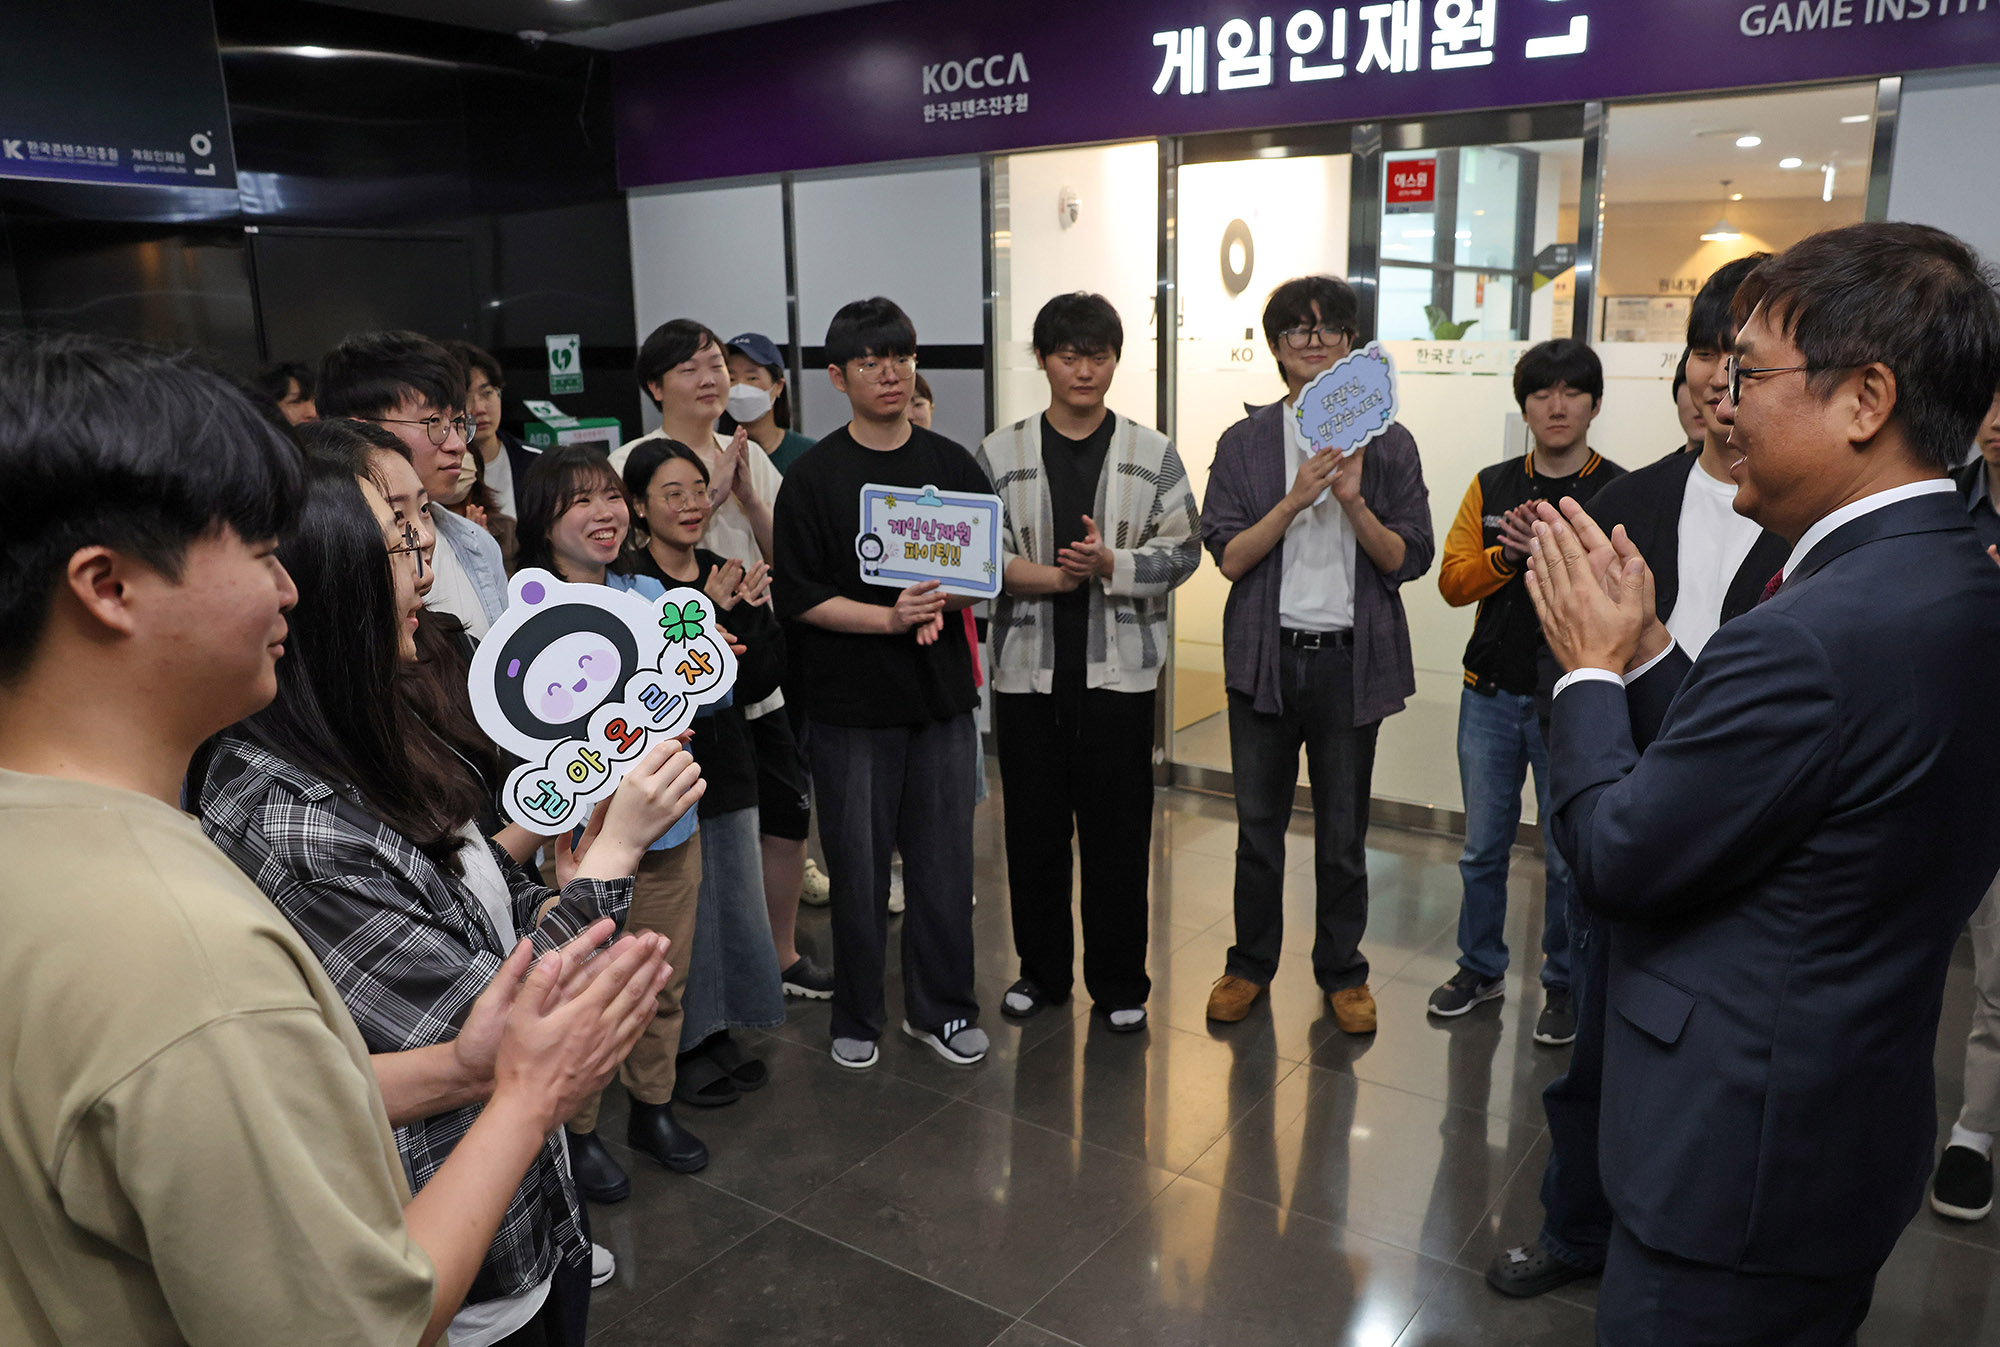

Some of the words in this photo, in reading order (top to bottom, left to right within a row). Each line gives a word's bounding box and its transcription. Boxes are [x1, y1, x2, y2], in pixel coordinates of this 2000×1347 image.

[1740, 0, 1853, 37] GAME
[1152, 0, 1496, 96] 게임인재원
[922, 51, 1030, 95] KOCCA
[923, 92, 1029, 123] 한국콘텐츠진흥원
[1394, 172, 1428, 188] 에스원
[1318, 388, 1384, 442] 반갑습니다!
[888, 516, 971, 546] 게임인재원
[904, 541, 961, 566] 파이팅!!
[523, 648, 714, 819] 날아오르자
